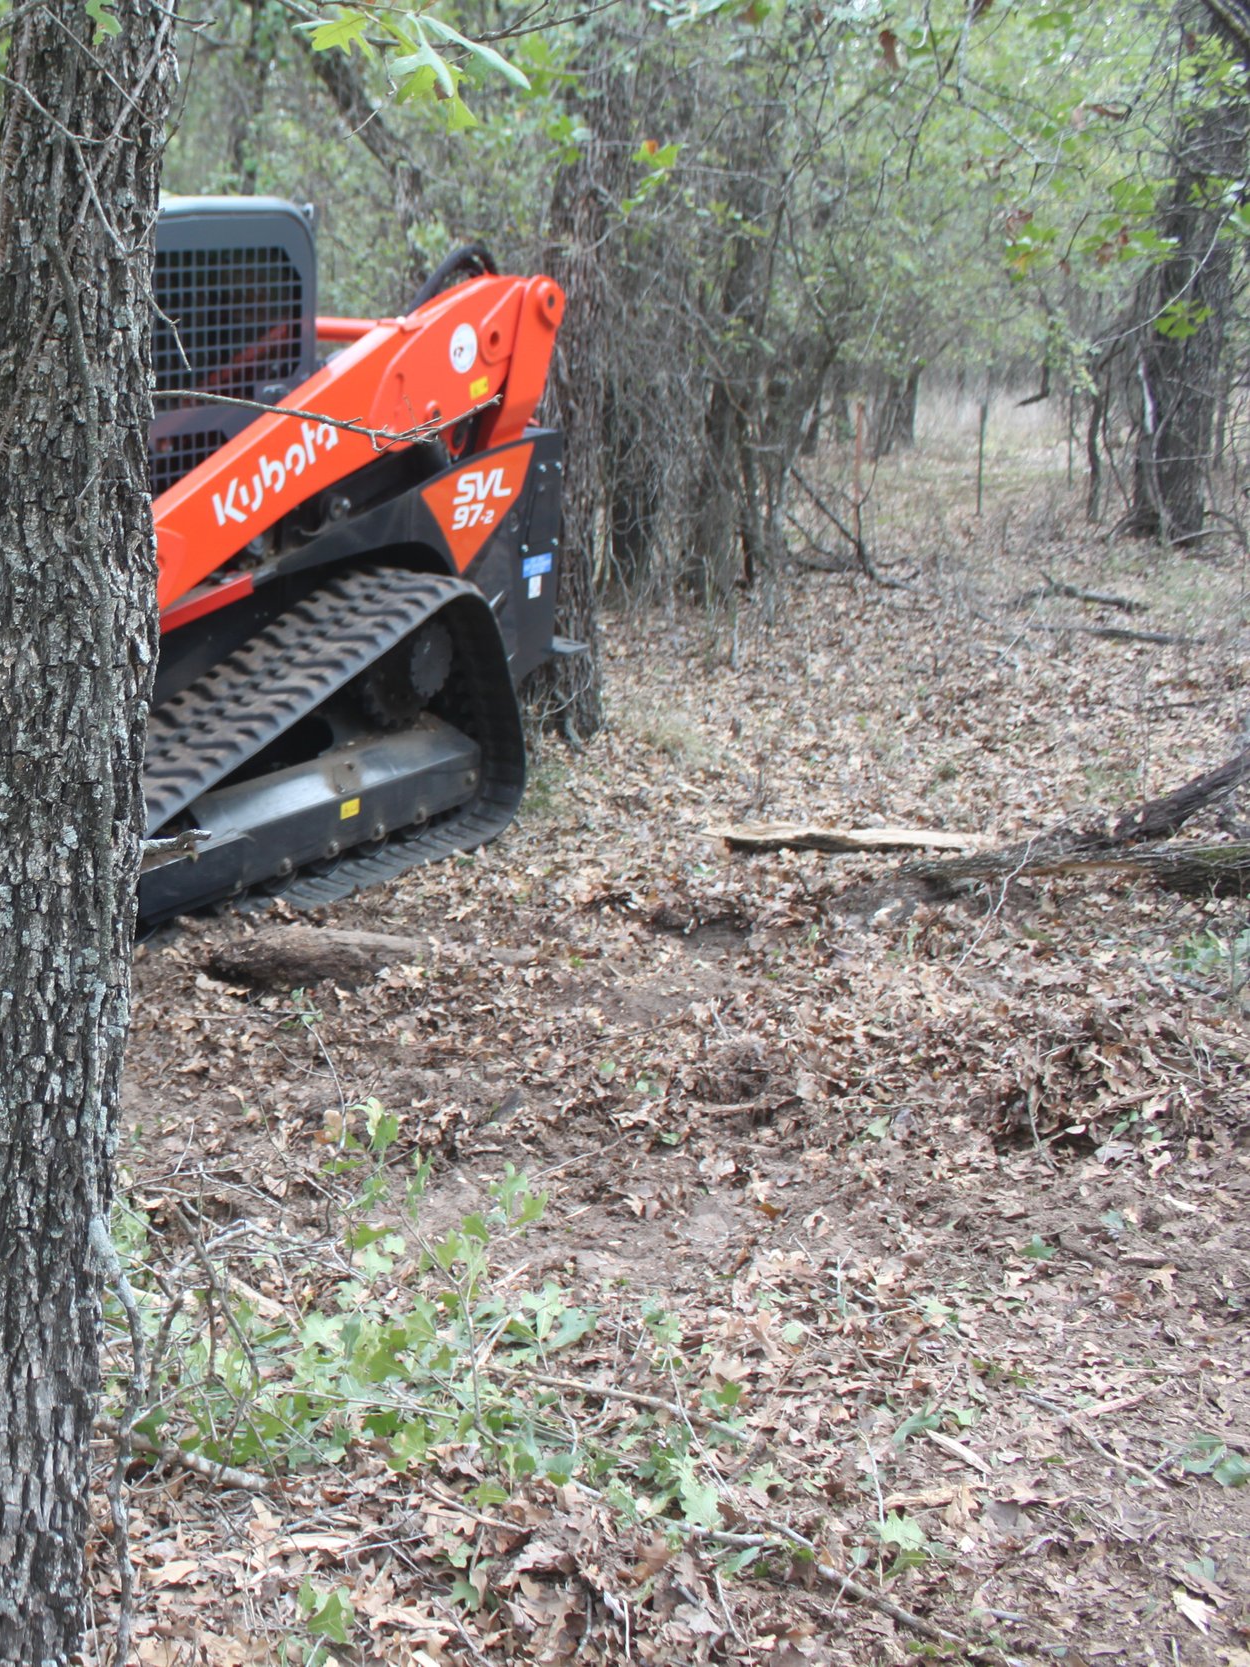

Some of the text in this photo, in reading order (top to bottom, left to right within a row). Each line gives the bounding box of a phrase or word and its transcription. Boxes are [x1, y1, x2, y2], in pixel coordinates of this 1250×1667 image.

[212, 421, 339, 527] Kubota
[452, 467, 512, 505] SVL
[451, 502, 495, 531] 97-2
